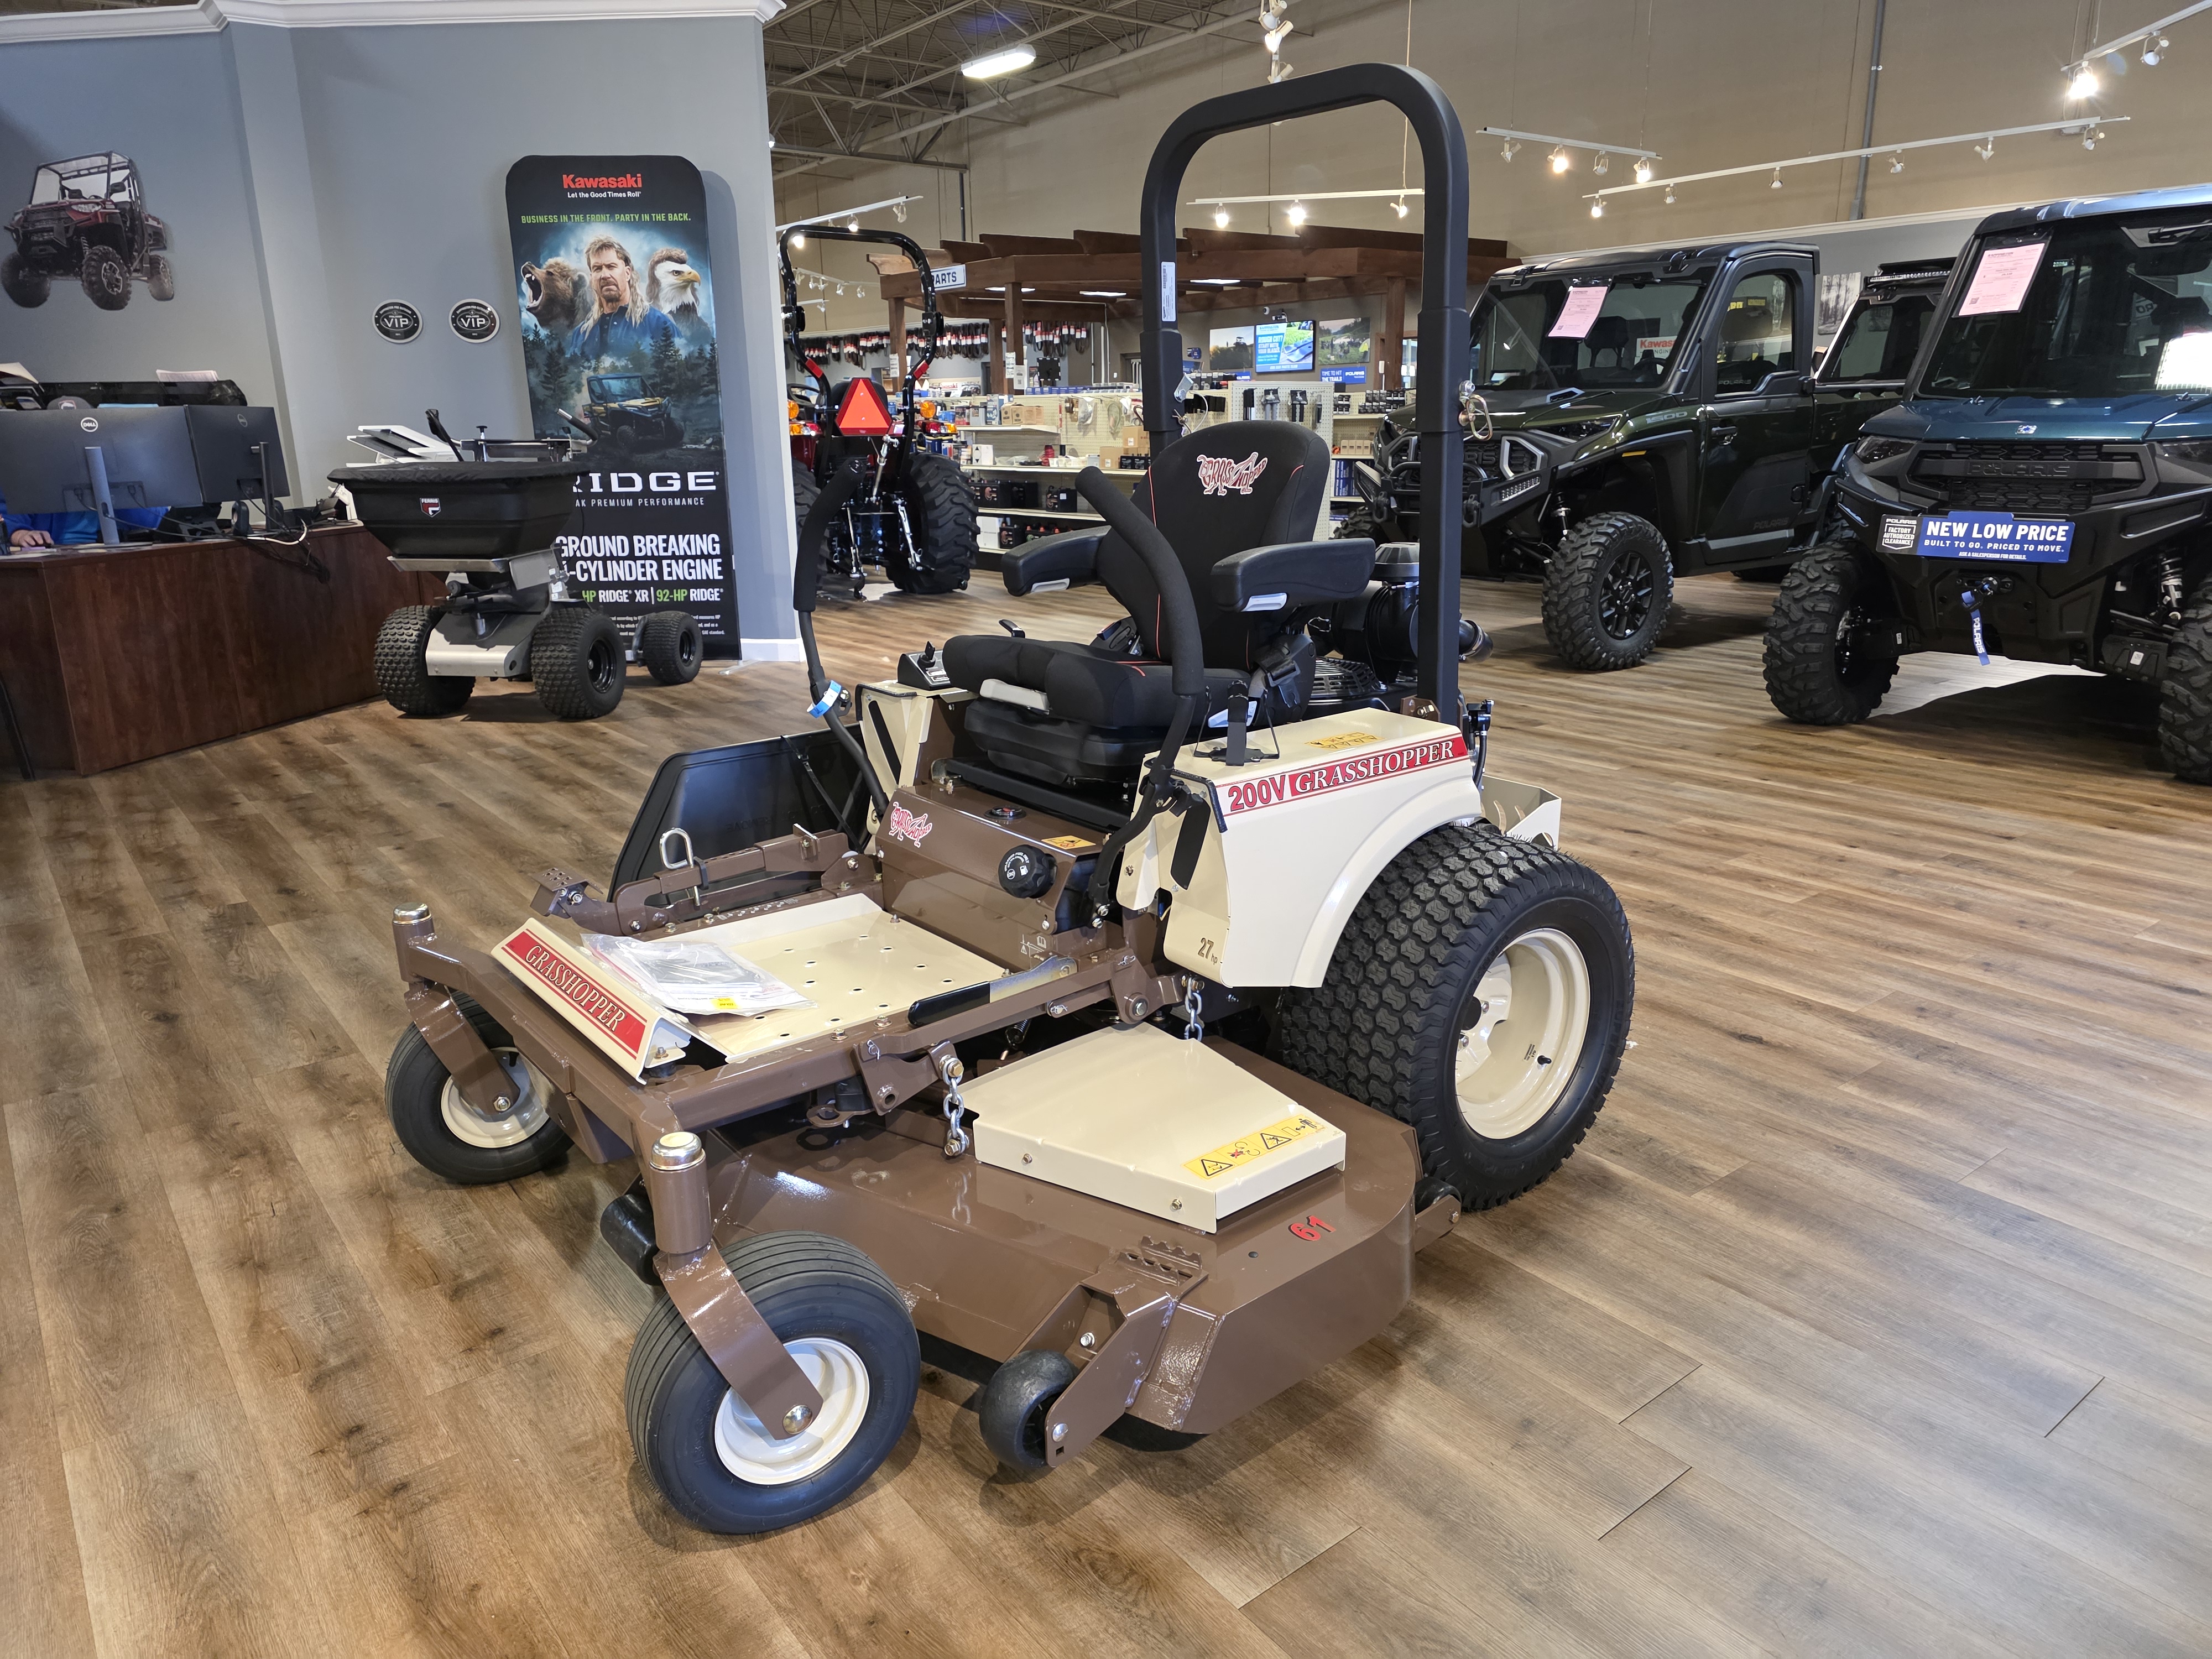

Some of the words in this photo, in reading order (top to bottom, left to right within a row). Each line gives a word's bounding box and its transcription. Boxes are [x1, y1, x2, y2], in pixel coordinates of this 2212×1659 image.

[562, 174, 642, 188] Kawasaki
[521, 215, 558, 223] BUSINESS
[586, 214, 613, 222] FRONT.
[615, 213, 639, 222] PARTY
[668, 213, 691, 221] BACK.
[384, 318, 409, 327] VIP
[461, 318, 486, 327] VIP
[1640, 340, 1675, 348] Kawas
[1967, 463, 2070, 477] POLARIS
[638, 498, 705, 507] PERFORMANCE
[1927, 521, 1969, 537] NEW
[1972, 523, 2013, 540] LOW
[2016, 525, 2069, 541] PRICE
[555, 535, 629, 557] GROUND
[633, 534, 720, 556] BREAKING
[662, 559, 723, 580] ENGINE
[634, 589, 649, 602] XR
[656, 589, 687, 602] 92-HP
[1973, 617, 1985, 654] POLARIS
[1228, 775, 1286, 811] 200V
[1295, 740, 1454, 793] GRASSHOPPER
[1197, 937, 1214, 959] 27
[1211, 953, 1218, 966] hp
[525, 945, 626, 1032] GRASSHOPPER
[1288, 1215, 1337, 1241] 61
